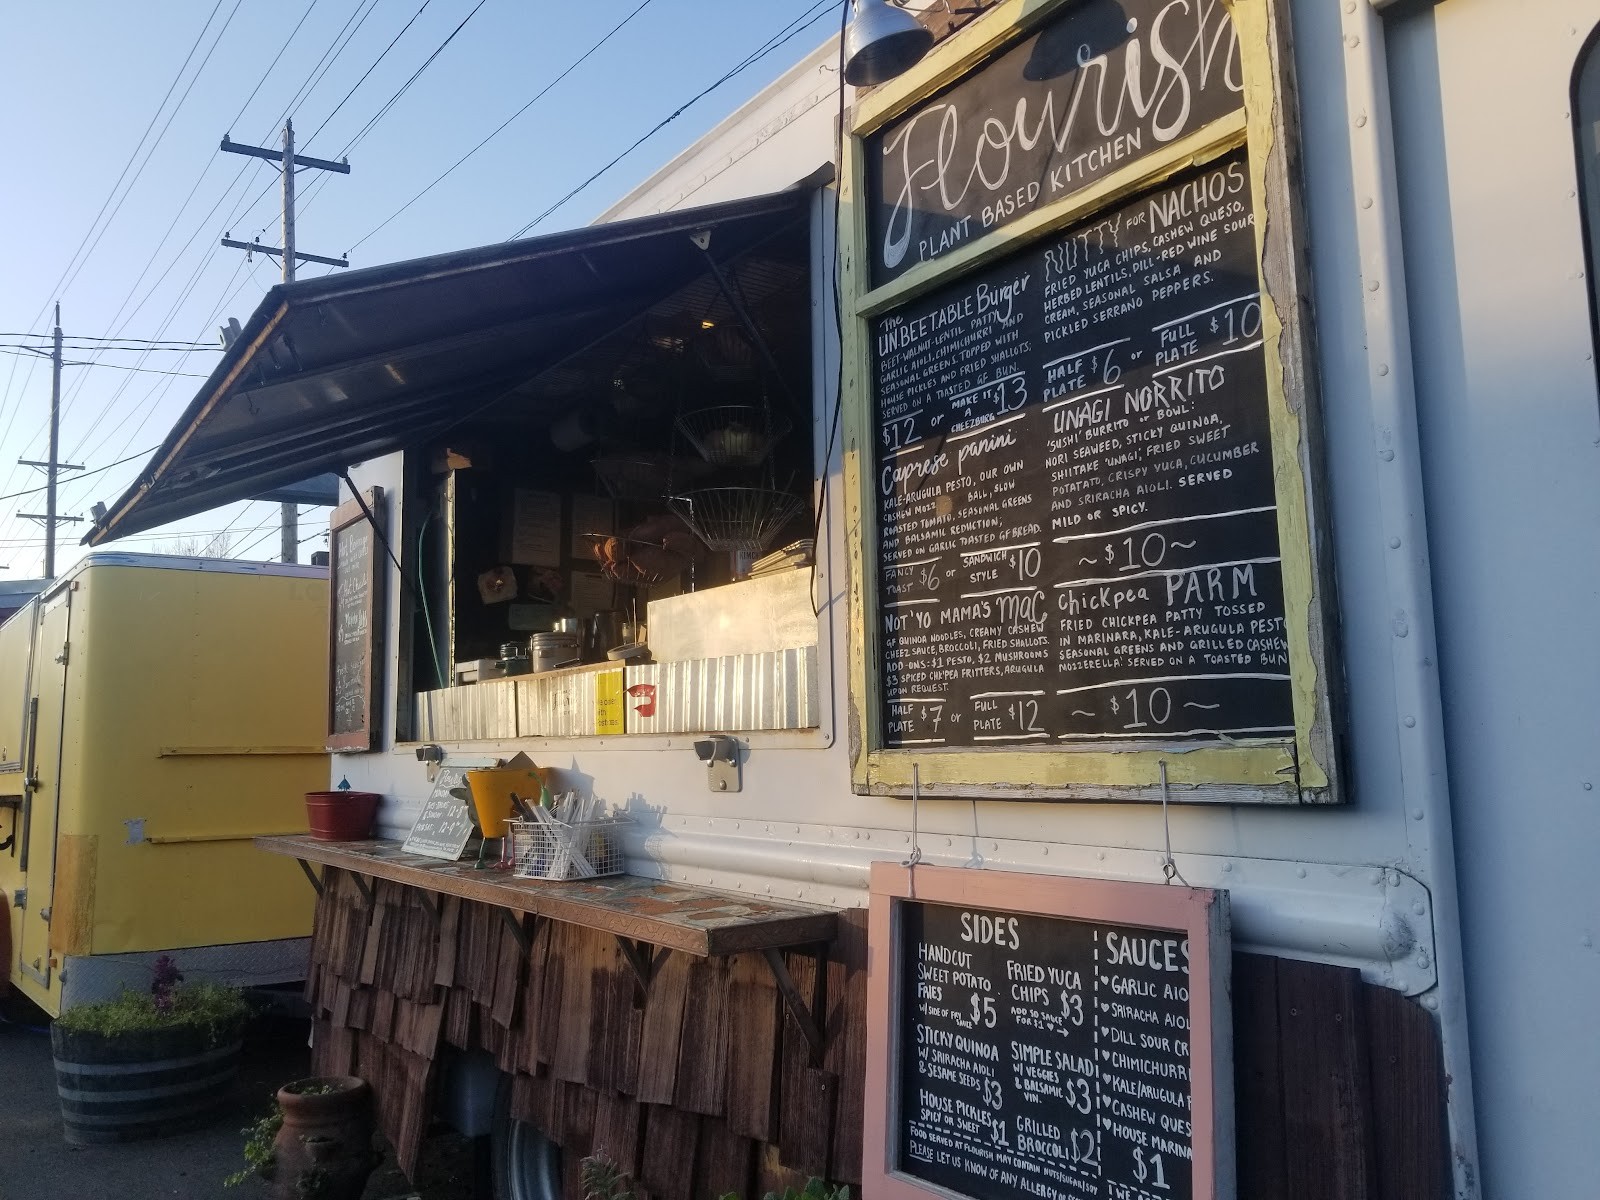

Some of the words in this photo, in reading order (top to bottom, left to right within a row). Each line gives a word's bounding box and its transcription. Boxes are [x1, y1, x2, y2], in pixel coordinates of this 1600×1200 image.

[883, 0, 1245, 269] Flourish
[919, 215, 971, 261] PLANT
[982, 181, 1040, 229] BASED
[1050, 127, 1142, 193] KITCHEN
[1045, 213, 1122, 281] NUTTY
[1126, 212, 1146, 230] FOR
[1150, 162, 1244, 233] NACHOS
[1044, 287, 1082, 312] HERBED
[1133, 245, 1184, 273] DILL-RED
[1188, 230, 1217, 249] WINE
[1224, 214, 1255, 234] SOUR
[1045, 275, 1076, 297] FRIED
[1084, 260, 1110, 279] YUCA
[1153, 222, 1194, 247] CASHEW
[977, 272, 1030, 323] Burger
[880, 315, 903, 332] The
[1044, 320, 1088, 343] PICKLED
[1093, 297, 1143, 324] SERRANO
[881, 368, 908, 384] GARLIC
[936, 326, 992, 359] CHIMICHURRI
[1002, 313, 1023, 330] AND
[1047, 359, 1082, 383] HALF
[1092, 349, 1121, 384] $6
[1131, 351, 1142, 360] or
[1161, 323, 1195, 347] FULL
[1210, 302, 1261, 345] $10
[1155, 339, 1198, 366] PLATE
[881, 391, 904, 408] HOUSE
[907, 377, 936, 395] PICKLES
[941, 369, 956, 384] AND
[960, 358, 986, 376] FRIED
[952, 393, 978, 409] MAKE
[983, 389, 991, 399] IT
[993, 377, 1027, 415] $13
[1043, 375, 1086, 402] PLATE
[1053, 398, 1110, 433] UNAGI
[1125, 365, 1225, 414] NORRITO
[965, 408, 971, 417] A
[1085, 419, 1129, 440] BURRITO
[883, 418, 922, 451] $12
[931, 414, 944, 426] or
[1045, 453, 1068, 468] NORI
[1126, 425, 1163, 445] STICKY
[882, 453, 948, 495] Caprese
[958, 429, 1016, 475] panini
[1108, 467, 1147, 483] CRISPY
[1190, 442, 1260, 465] CUCUMBER
[884, 485, 942, 511] KALE-ARUGULA
[980, 468, 997, 481] OUR
[1004, 460, 1023, 474] OWN
[1052, 515, 1081, 530] MILD
[1087, 511, 1101, 521] OR
[883, 547, 912, 562] SERVED
[916, 545, 925, 554] ON
[929, 538, 956, 553] GARLIC
[960, 533, 995, 546] TOASTED
[999, 529, 1010, 540] GF
[886, 566, 914, 581] FANCY
[919, 564, 939, 591] $6
[946, 569, 956, 577] or
[963, 551, 1007, 568] SANDWICH
[1009, 548, 1041, 580] $10
[887, 582, 913, 595] TOAST
[970, 569, 998, 583] STYLE
[1059, 586, 1150, 615] Chickpea
[1166, 564, 1257, 606] PARM
[941, 601, 991, 625] MAMA'S
[1060, 619, 1093, 632] FRIED
[1102, 614, 1157, 628] CHICKPEA
[1166, 607, 1202, 622] PATTY
[1215, 602, 1266, 617] TOSSED
[983, 639, 1007, 649] FRIED
[1010, 637, 1049, 648] SHALLOTS.
[1059, 635, 1071, 646] IN
[931, 657, 944, 669] $1
[978, 653, 991, 663] $2
[995, 650, 1048, 662] MUSHROOMS
[887, 688, 907, 696] UPON
[911, 683, 949, 693] REQUEST.
[889, 721, 914, 733] PLATE
[974, 718, 1001, 730] PLATE
[892, 704, 913, 716] HALF
[921, 705, 942, 732] $7
[951, 713, 961, 723] or
[975, 700, 997, 711] FULL
[1008, 700, 1044, 731] $12
[960, 912, 1019, 950] SIDES
[918, 942, 972, 969] HANDCUT
[918, 962, 949, 984] SWEET
[953, 971, 991, 991] POTATO
[918, 982, 942, 1001] FRIES
[1007, 960, 1045, 983] FRIED
[1048, 967, 1081, 991] YUCA
[1111, 975, 1157, 998] GARLIC
[970, 992, 997, 1028] $5
[1011, 984, 1049, 1006] CHIPS
[1061, 990, 1084, 1026] $3
[1111, 1002, 1159, 1024] SRIRACHA
[917, 1024, 954, 1049] STICKY
[955, 1035, 999, 1062] QUINOA
[1011, 1041, 1052, 1066] SIMPLE
[1055, 1051, 1094, 1077] SALAD
[920, 1089, 953, 1113] HOUSE
[956, 1100, 991, 1127] PICKLES
[983, 1077, 1003, 1110] $3
[1066, 1078, 1091, 1114] $3
[1112, 1075, 1185, 1108] KALE/ARUGULA
[991, 1119, 1009, 1147] $1
[1016, 1115, 1061, 1140] GRILLED
[1113, 1121, 1148, 1146] HOUSE
[1018, 1134, 1068, 1160] BROCCOLI
[1070, 1128, 1098, 1166] $2
[1133, 1146, 1170, 1190] $1
